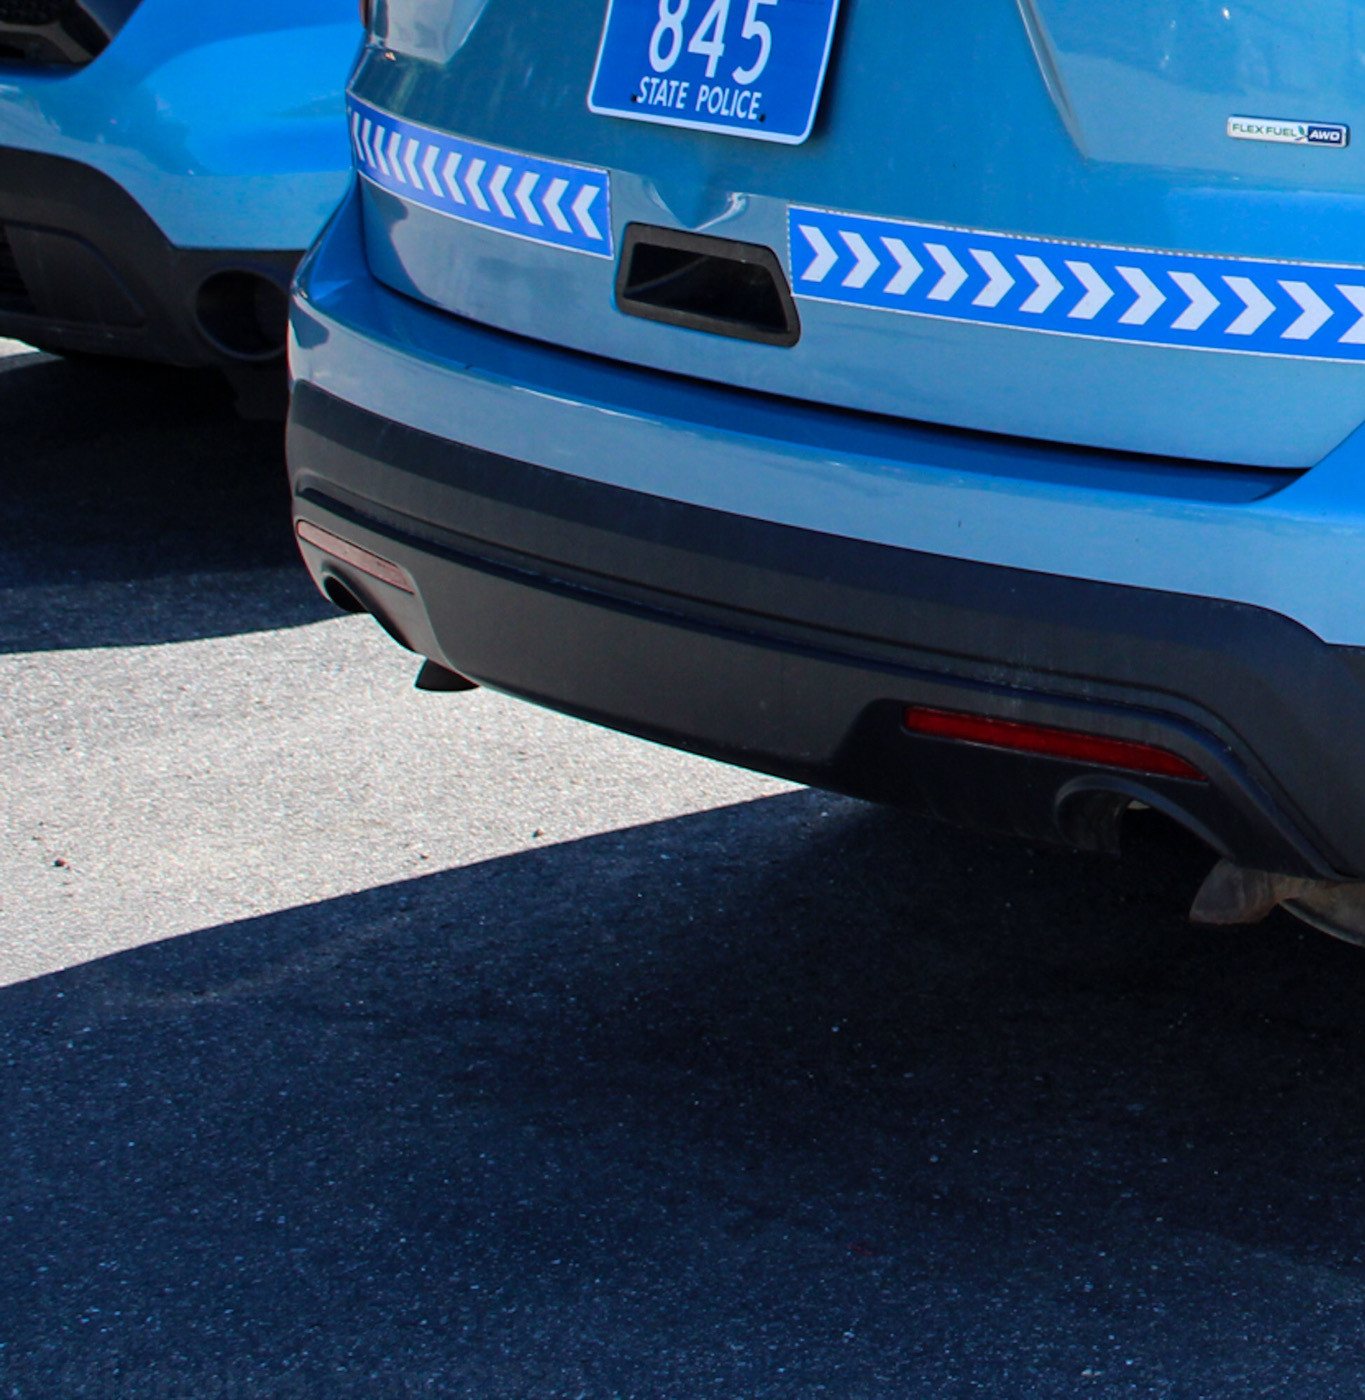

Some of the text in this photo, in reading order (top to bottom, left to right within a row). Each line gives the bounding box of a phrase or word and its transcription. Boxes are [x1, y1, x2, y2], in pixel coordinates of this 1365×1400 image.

[635, 76, 763, 121] STATE POLICE
[1231, 122, 1341, 142] FLEX FUEL AWD
